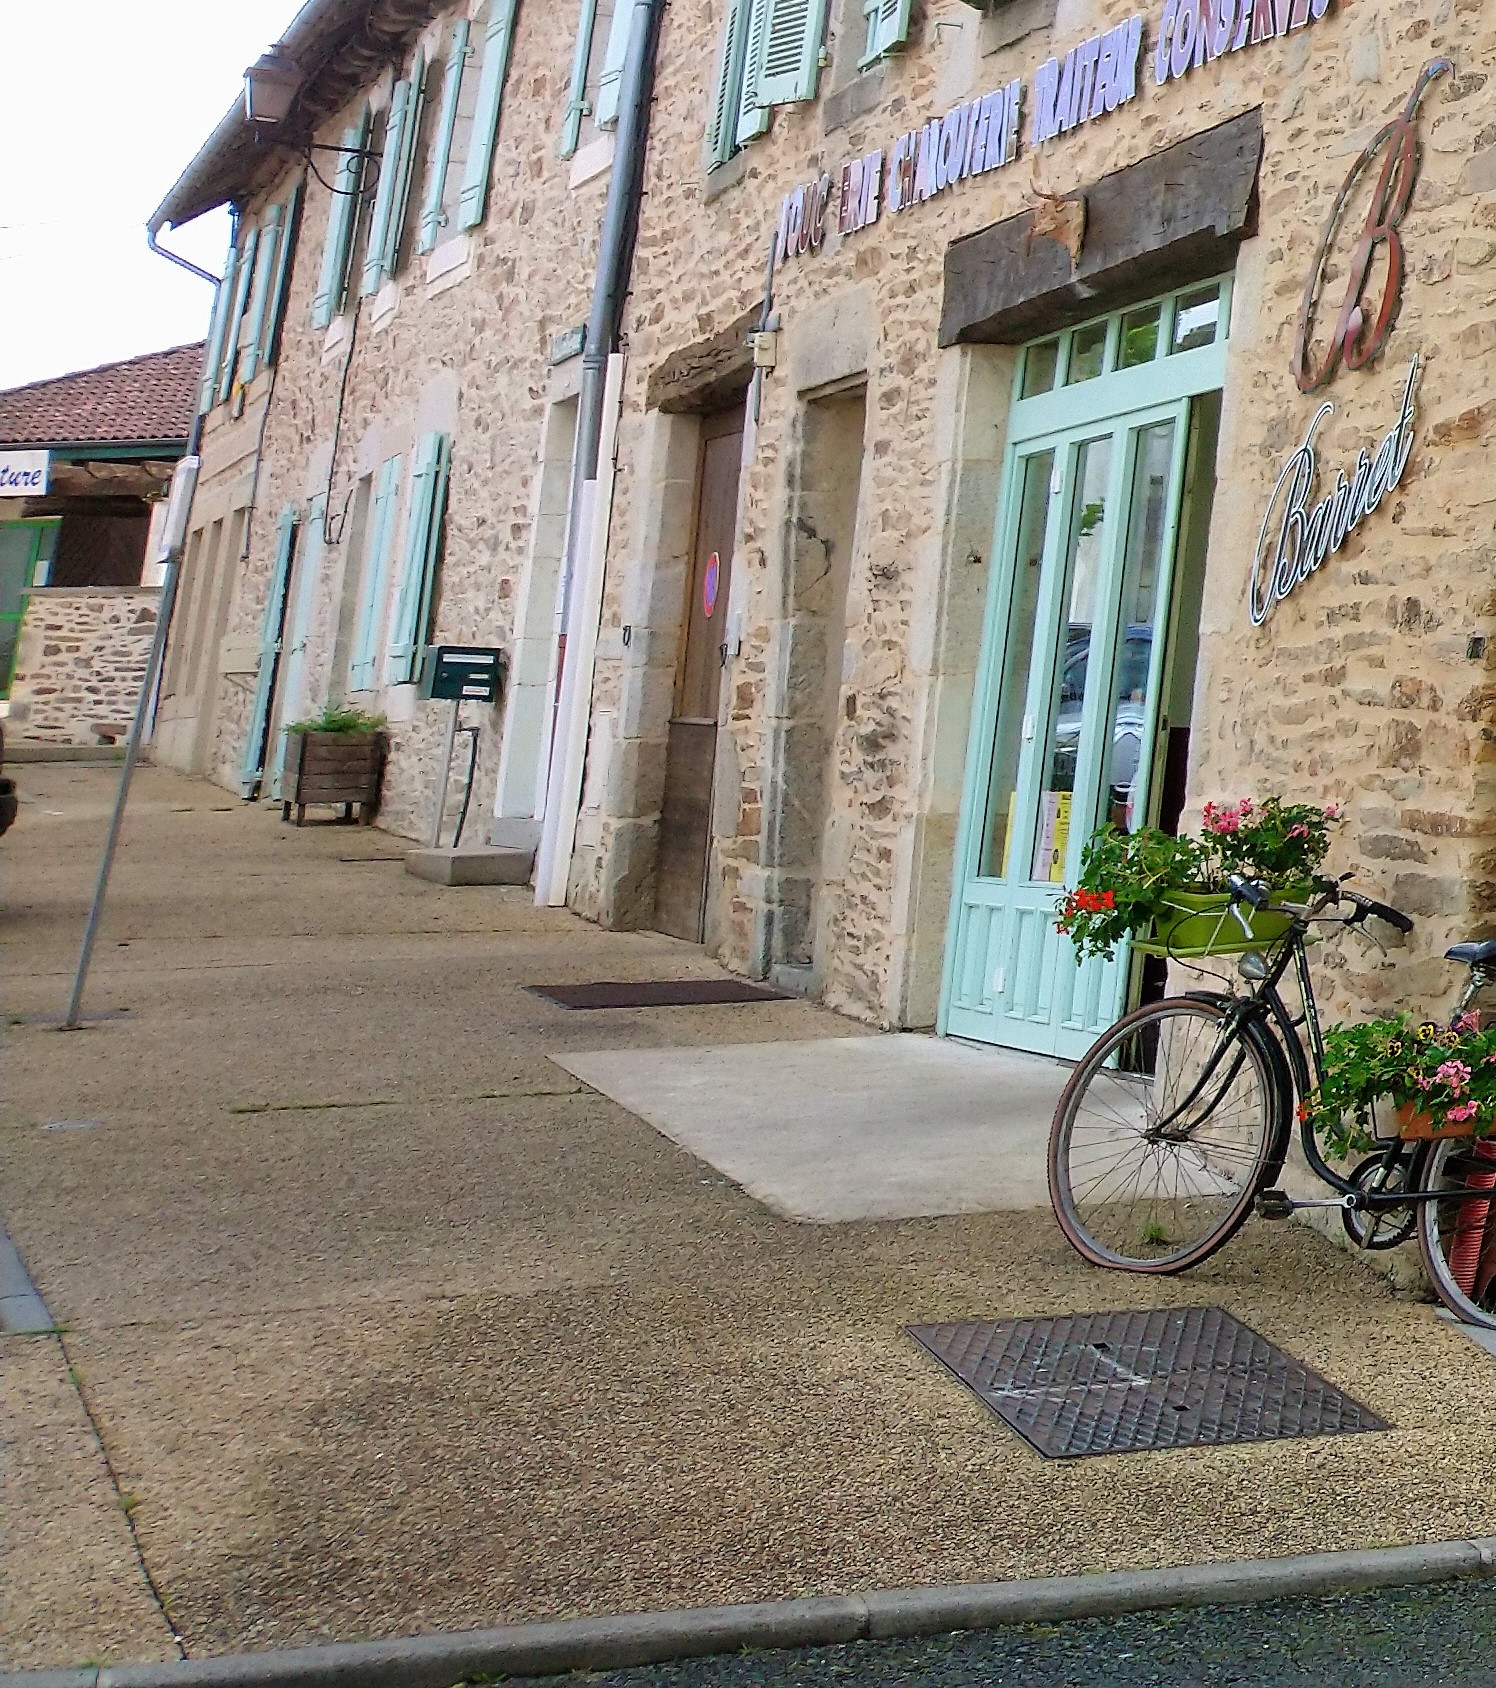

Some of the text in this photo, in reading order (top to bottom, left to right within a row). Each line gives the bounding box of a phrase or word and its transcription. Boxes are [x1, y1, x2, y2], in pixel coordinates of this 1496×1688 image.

[1032, 13, 1143, 148] TRAITEUR
[1292, 56, 1456, 394] B
[0, 464, 42, 487] ture
[1249, 353, 1420, 627] Barret
